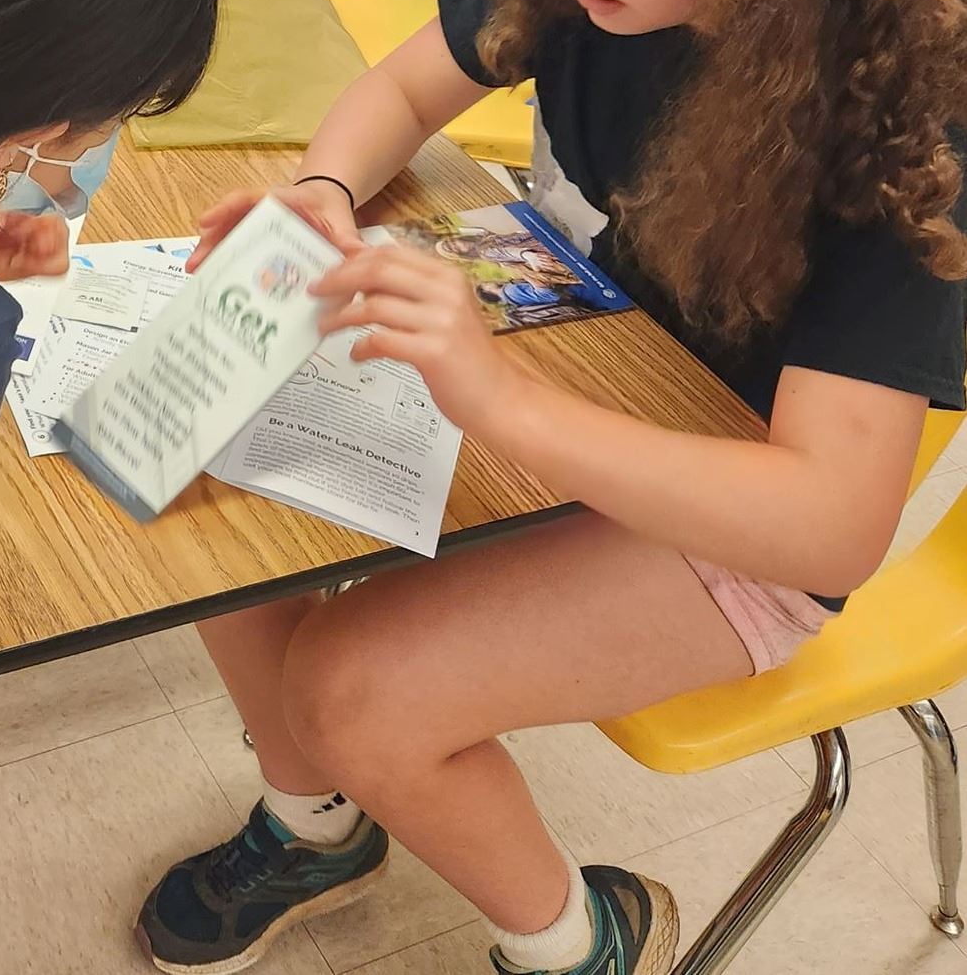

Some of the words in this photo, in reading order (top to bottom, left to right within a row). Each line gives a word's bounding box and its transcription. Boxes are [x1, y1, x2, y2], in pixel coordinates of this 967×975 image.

[269, 417, 284, 426] Be
[297, 424, 333, 442] Water
[335, 437, 363, 455] Leak
[365, 449, 422, 479] Detective
